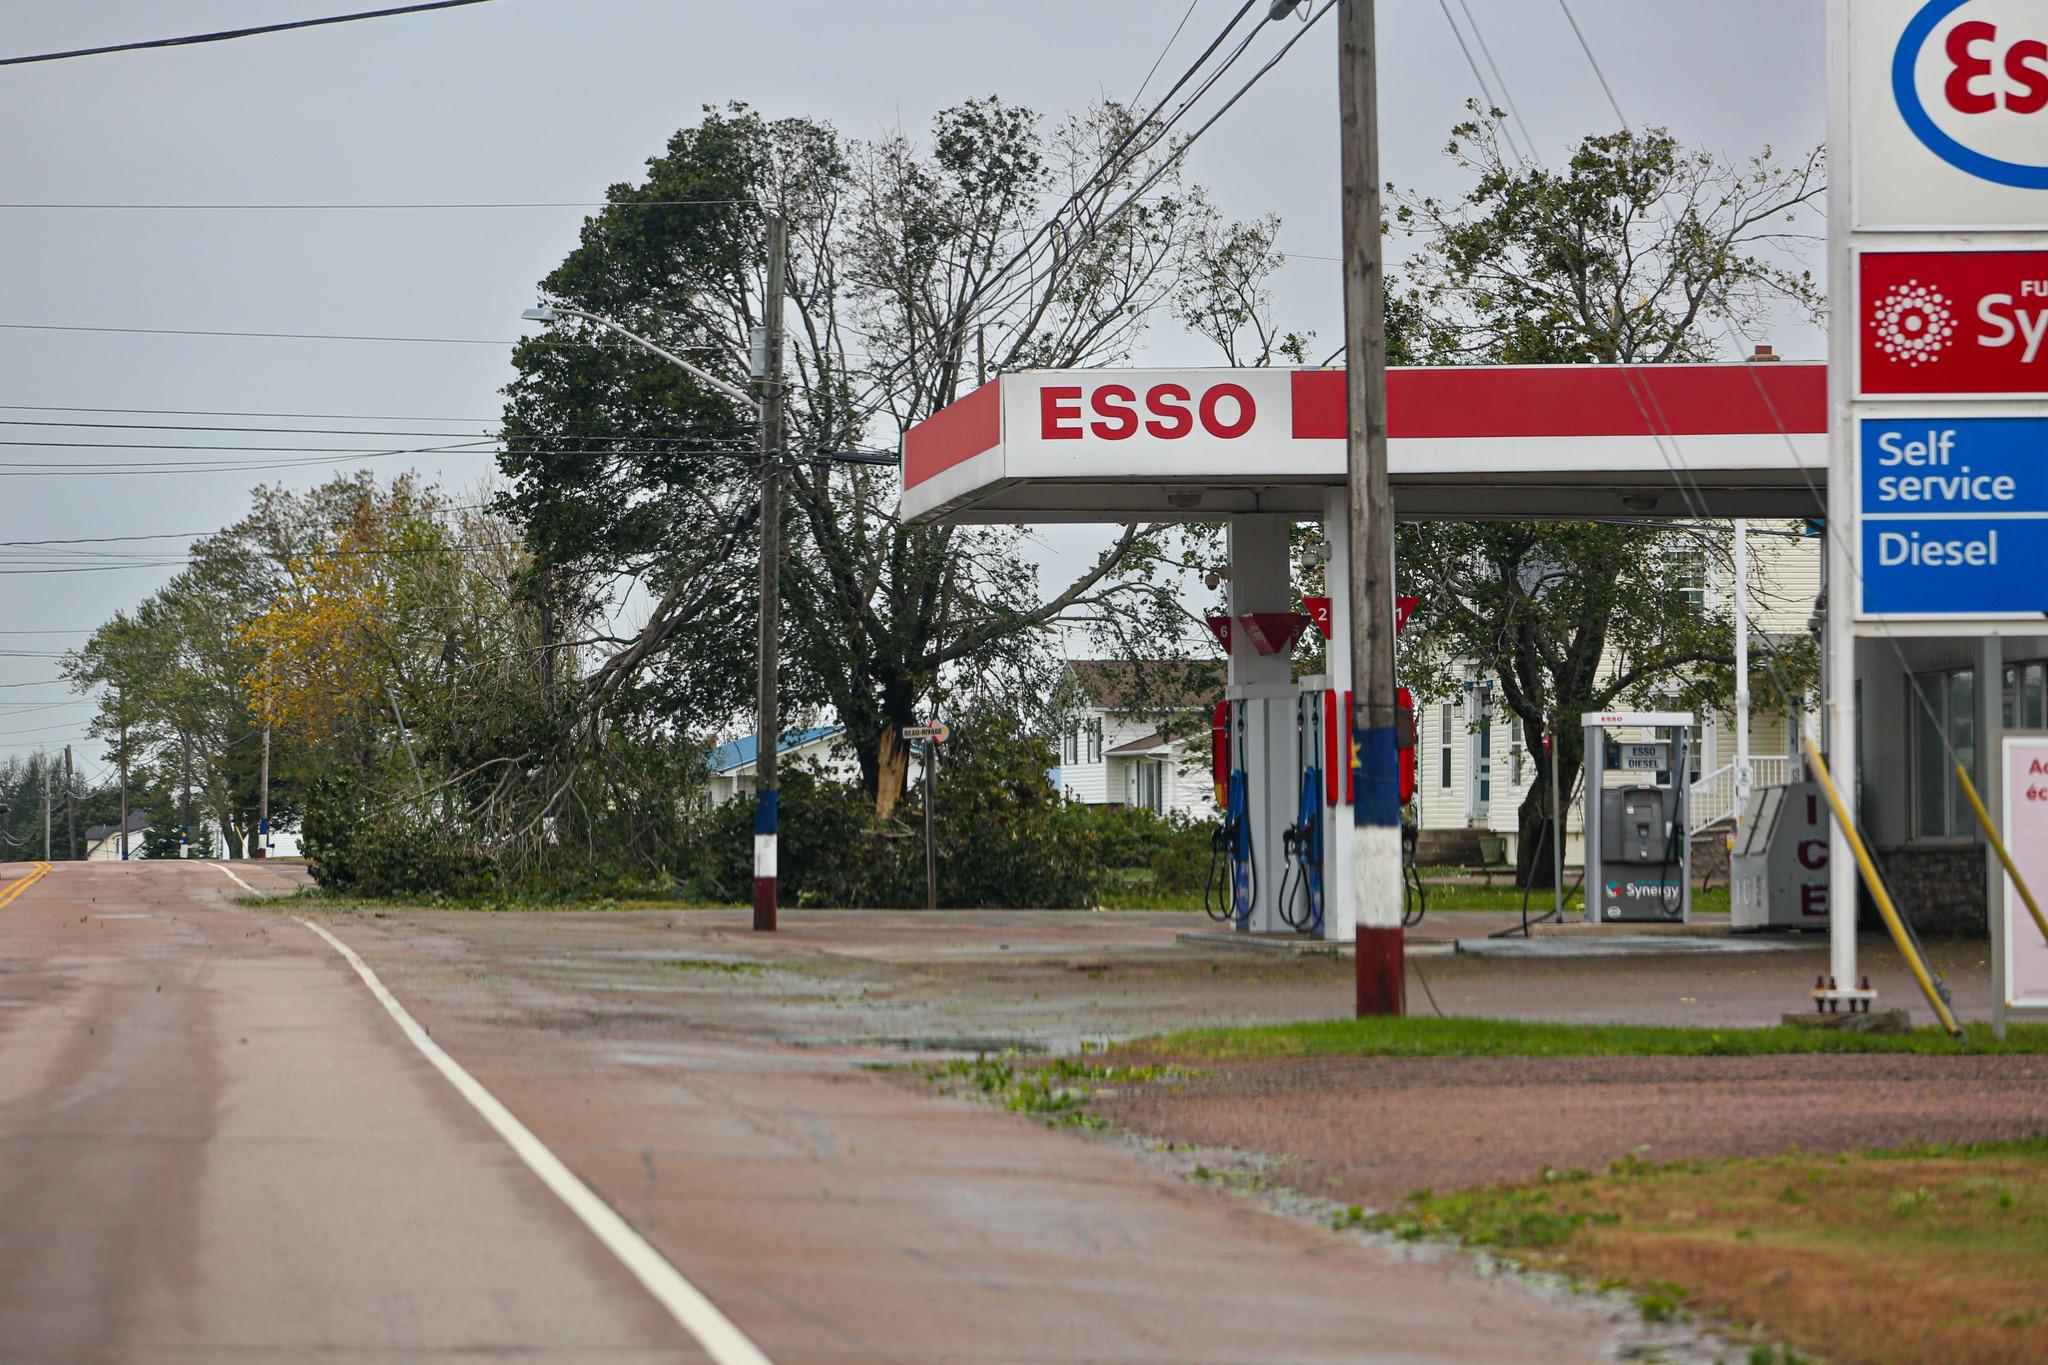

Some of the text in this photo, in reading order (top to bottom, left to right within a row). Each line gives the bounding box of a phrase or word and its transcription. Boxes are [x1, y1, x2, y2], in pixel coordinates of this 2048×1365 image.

[1040, 383, 1257, 440] ESSO
[1878, 429, 1957, 466] Self
[1878, 466, 2016, 501] service
[1878, 530, 1998, 566] Diesel
[1318, 608, 1328, 621] 2
[1395, 607, 1402, 621] 1
[1220, 625, 1228, 637] 6
[904, 729, 941, 737] BEAU-RIVAGE
[1632, 747, 1655, 756] ESSO
[1629, 760, 1659, 768] DIESEL
[1797, 794, 1829, 916] ICE
[1626, 883, 1679, 900] Synergy
